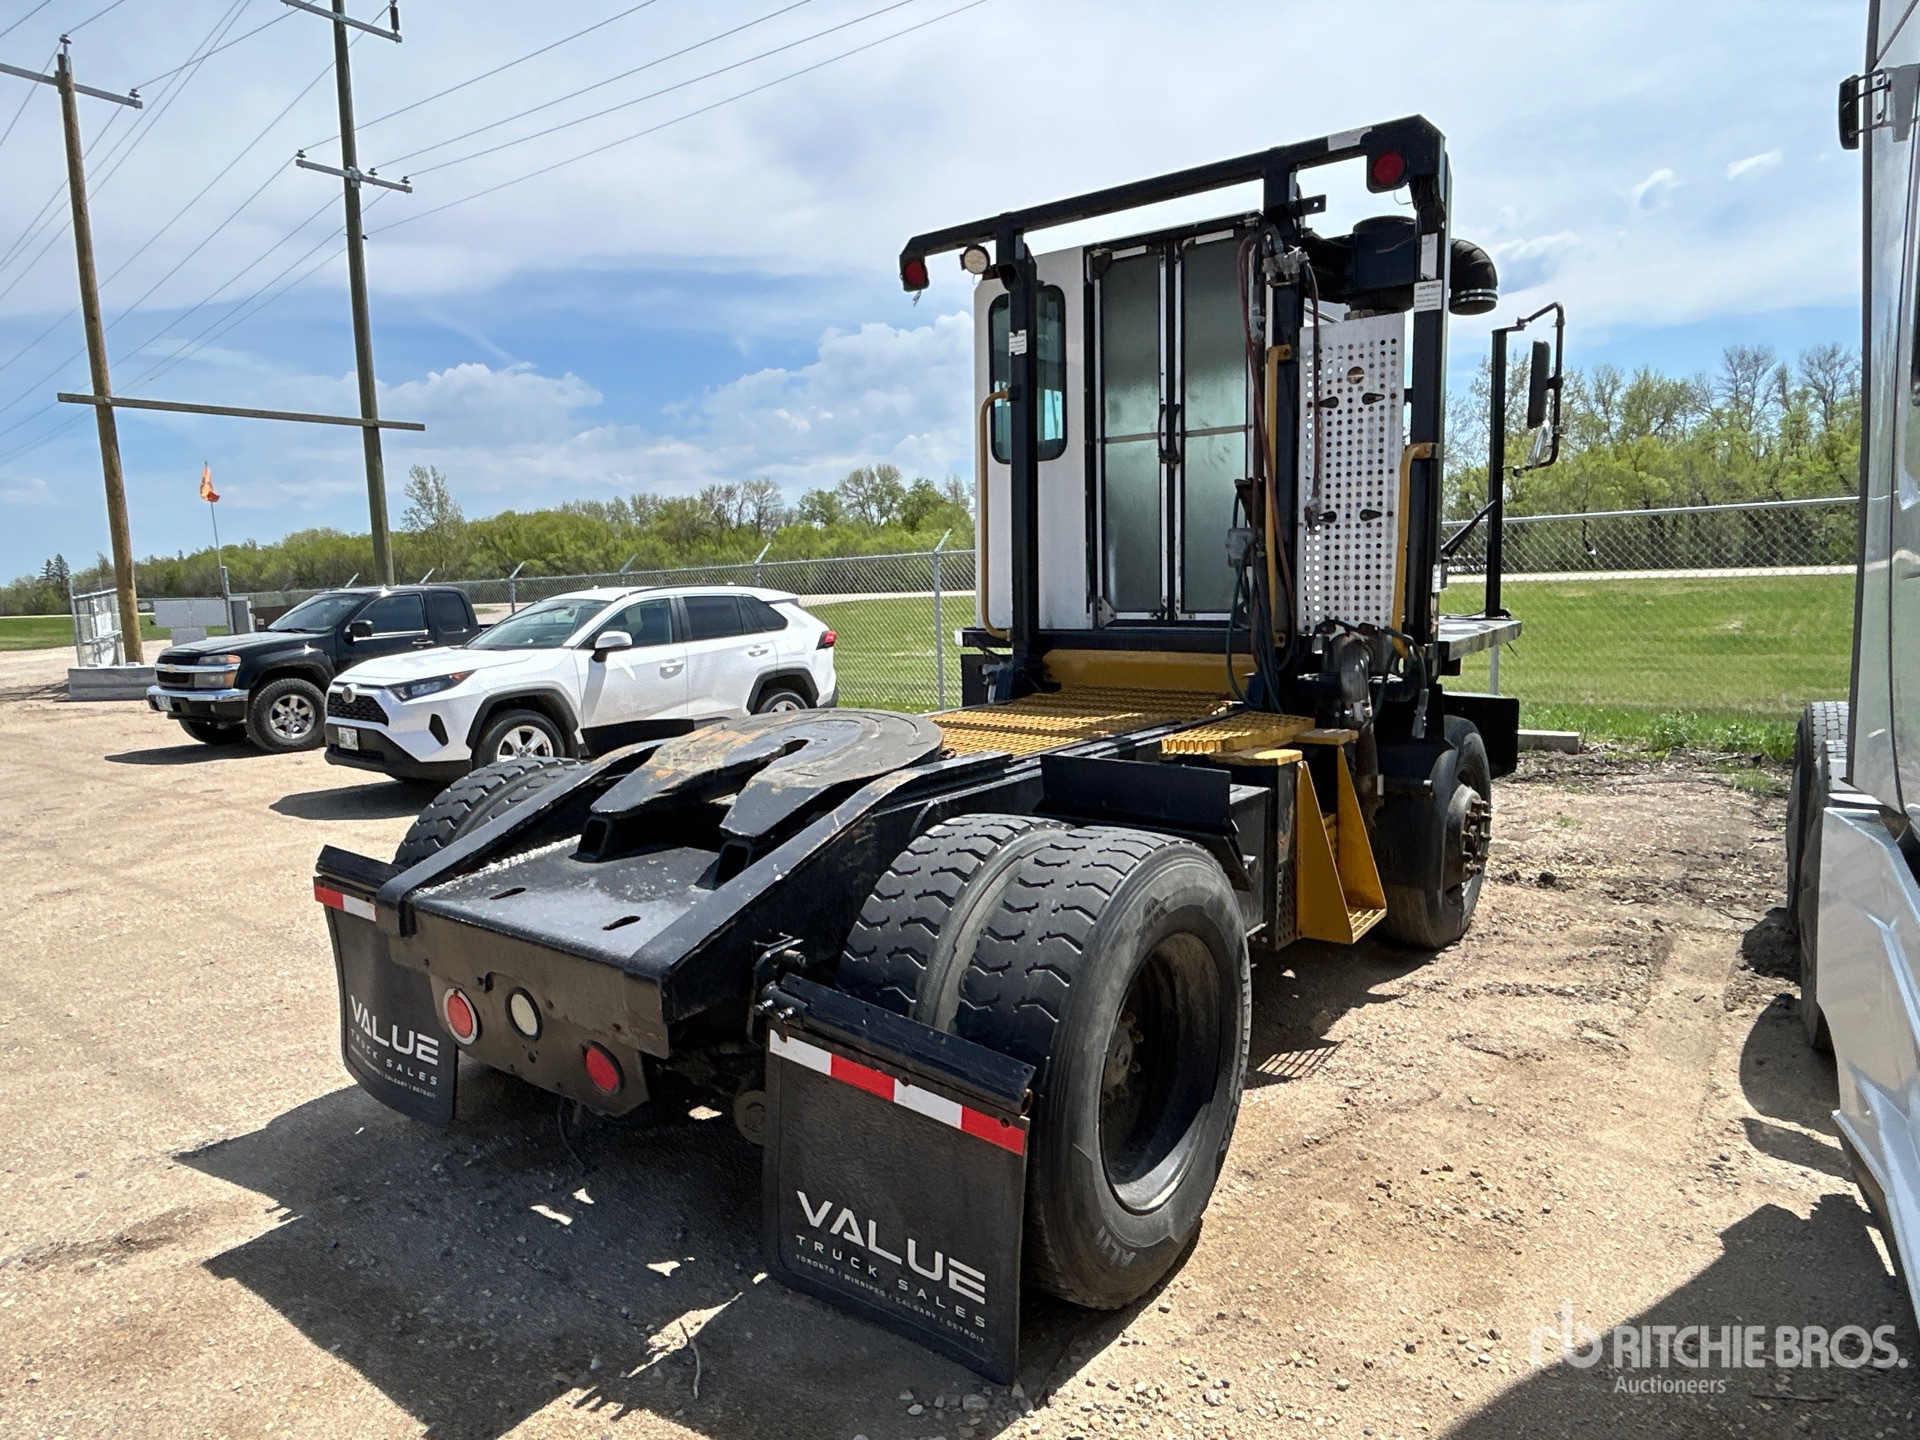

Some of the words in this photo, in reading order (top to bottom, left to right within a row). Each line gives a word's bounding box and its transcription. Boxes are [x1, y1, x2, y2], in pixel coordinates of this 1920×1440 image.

[350, 994, 439, 1066] VALUE
[386, 1058, 438, 1086] SALES
[796, 1190, 985, 1305] VALUE
[796, 1234, 877, 1278] TRUCK
[898, 1279, 985, 1328] SALES
[796, 1254, 835, 1275] TORONTO
[844, 1273, 886, 1297] WINNIPEG
[895, 1297, 936, 1319] CALGARY
[946, 1320, 985, 1344] DETROIT
